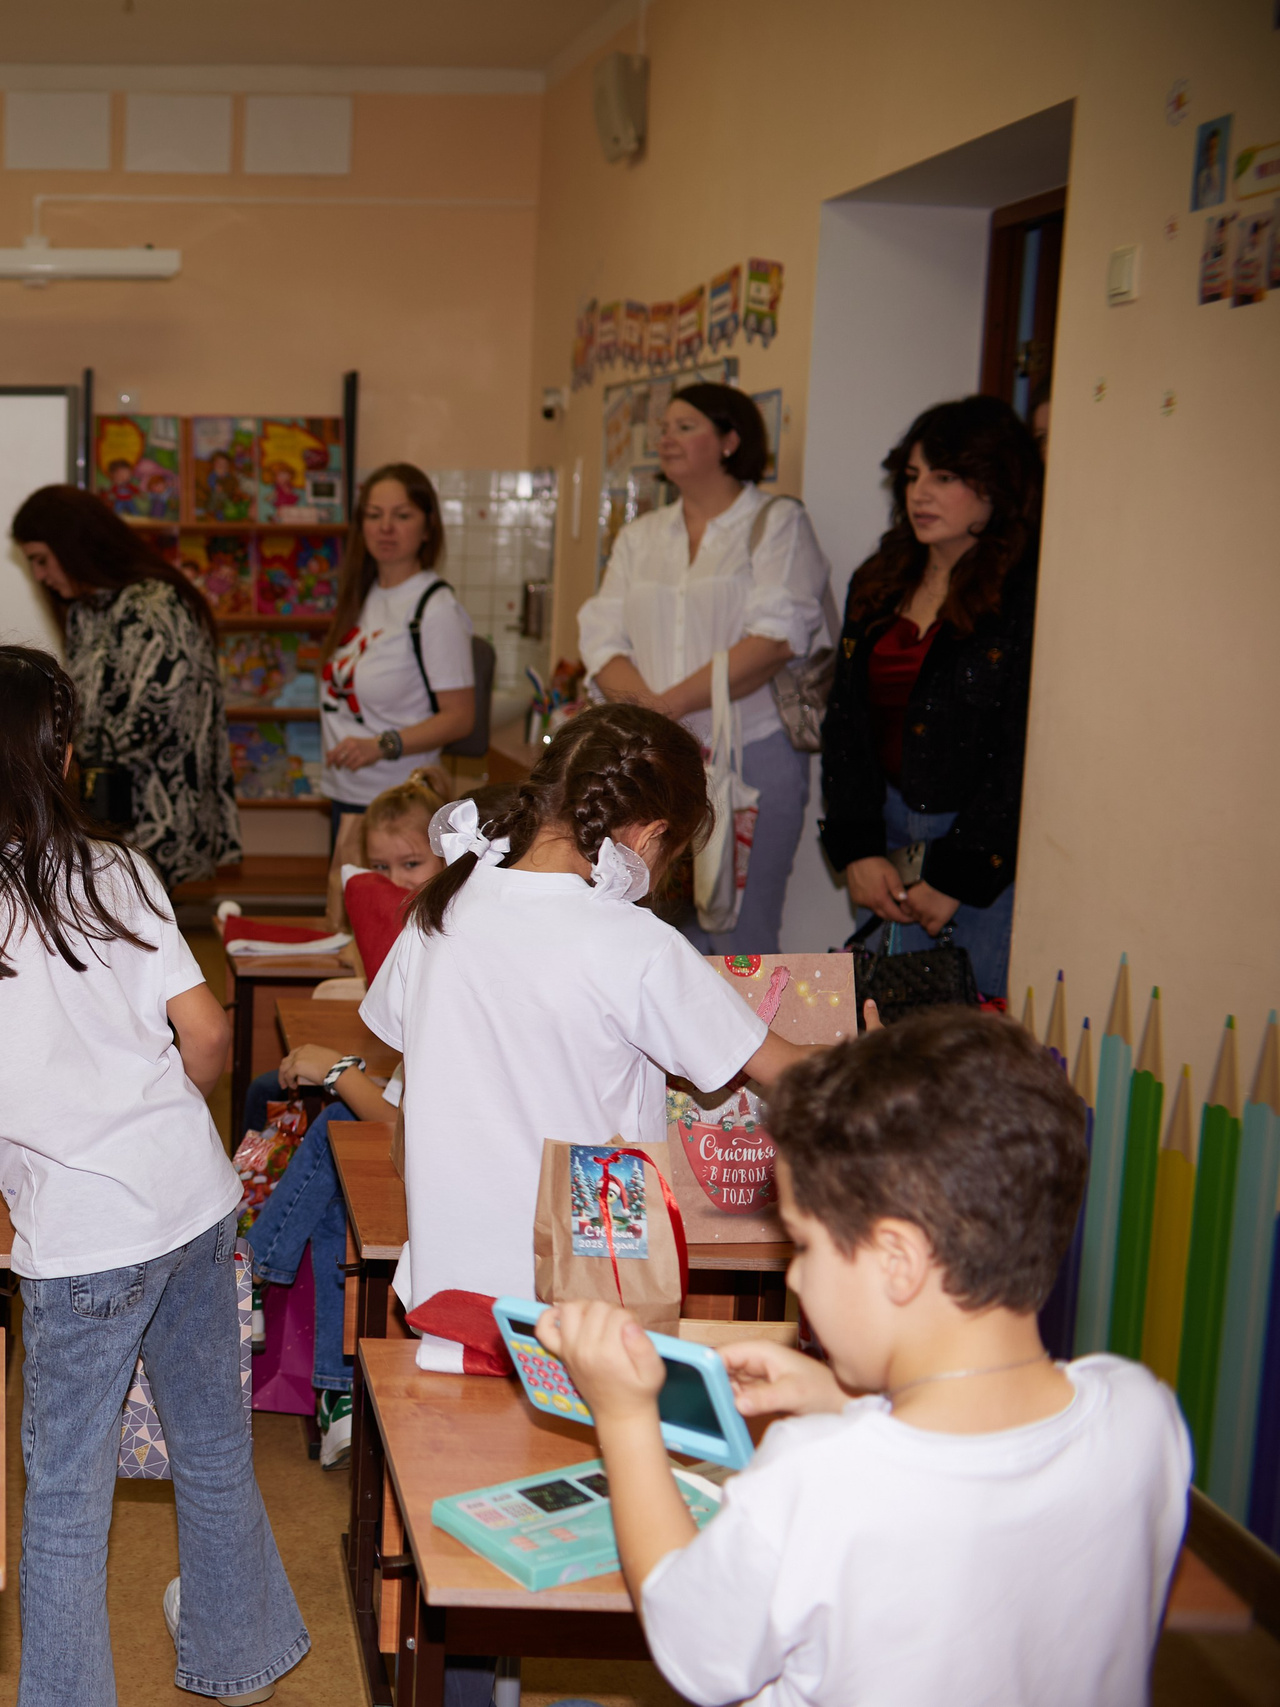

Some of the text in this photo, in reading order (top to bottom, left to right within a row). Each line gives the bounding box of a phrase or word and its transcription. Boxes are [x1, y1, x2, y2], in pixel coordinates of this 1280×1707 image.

[699, 1134, 777, 1163] Счастья
[721, 1166, 768, 1184] НОВОМ
[722, 1187, 755, 1206] ГОДУ
[578, 1239, 604, 1249] 2025
